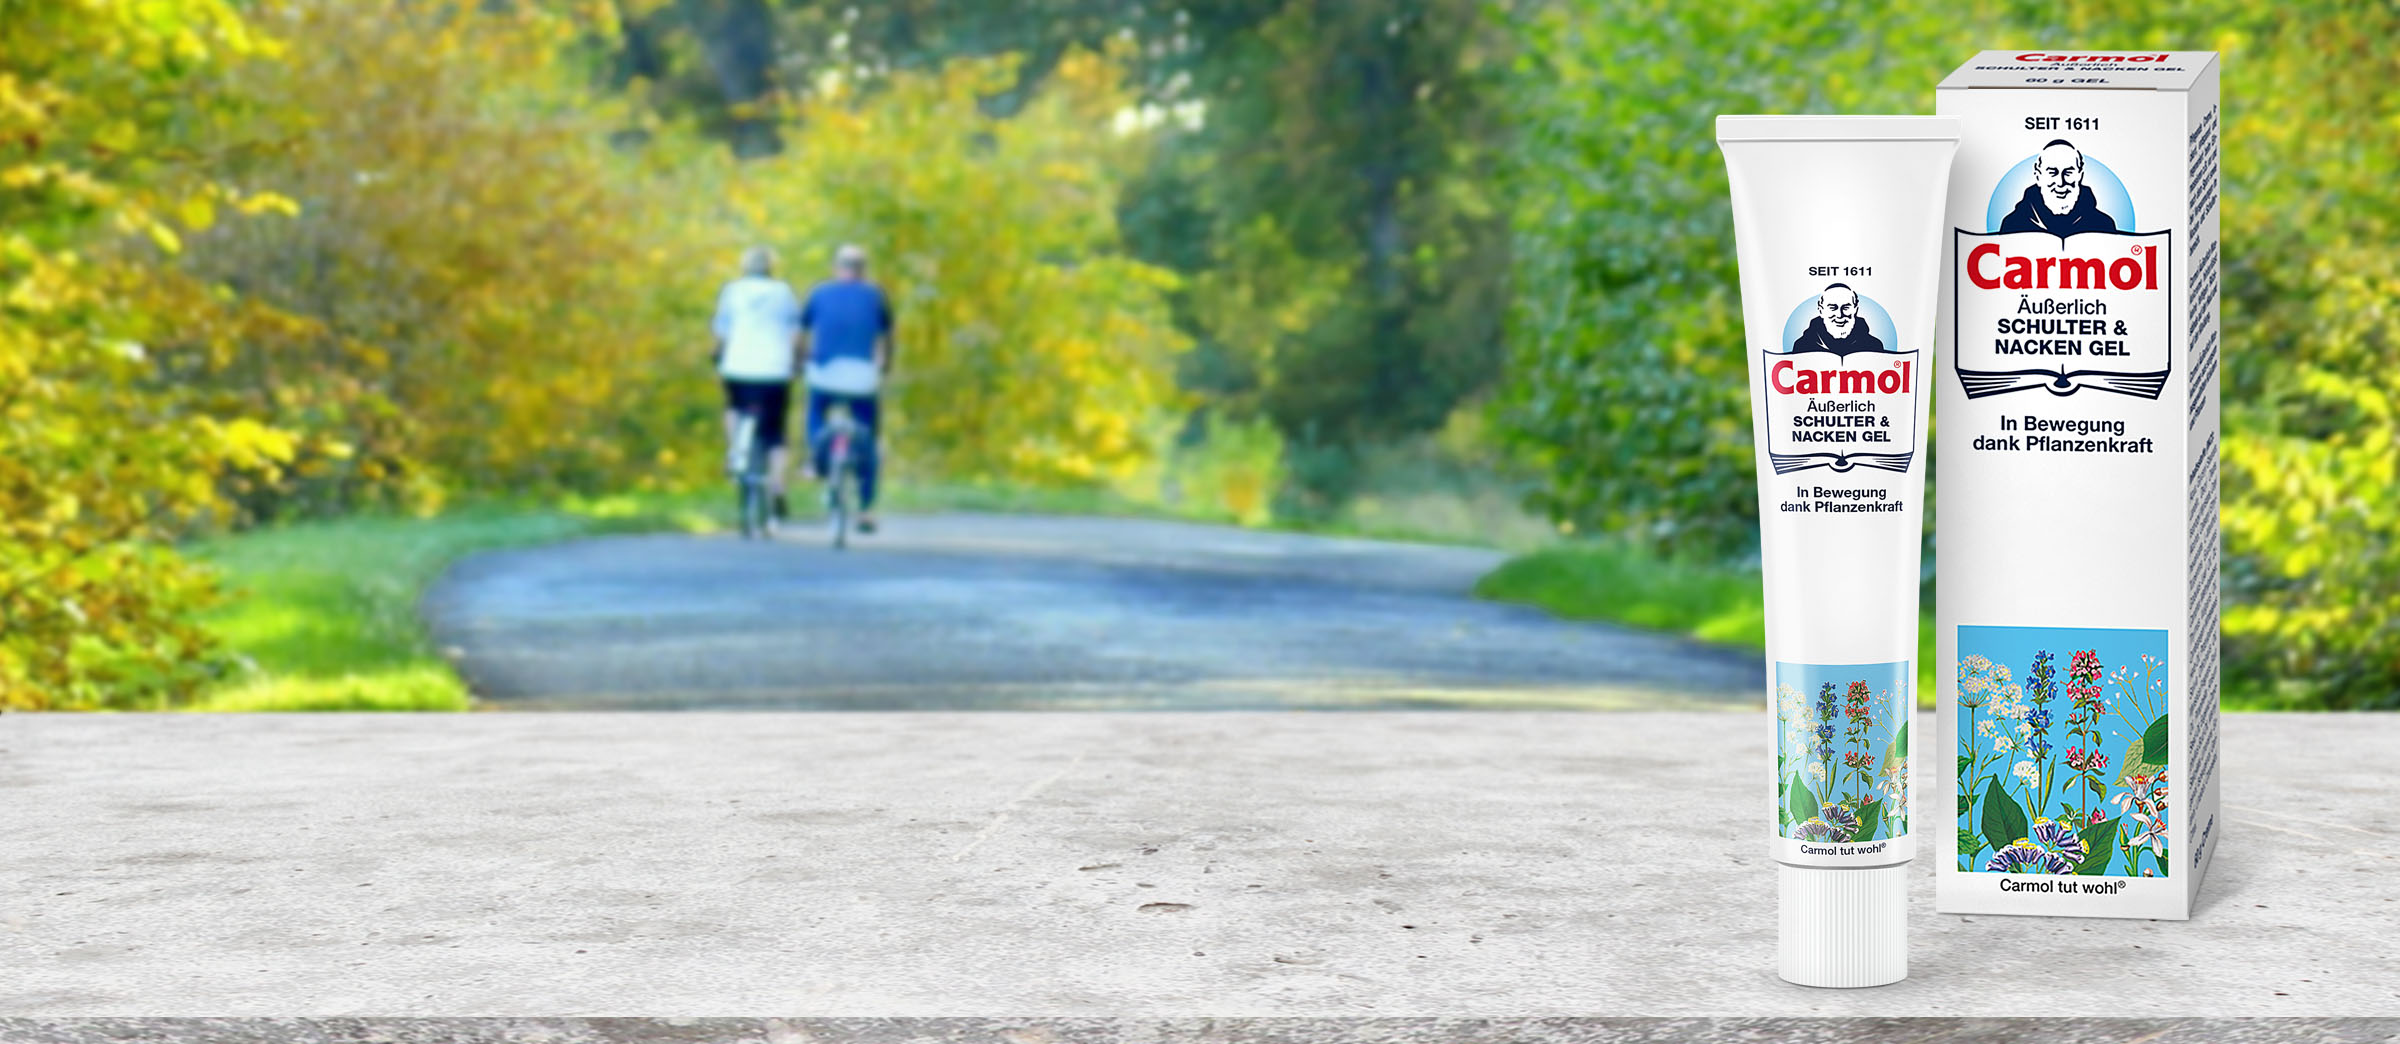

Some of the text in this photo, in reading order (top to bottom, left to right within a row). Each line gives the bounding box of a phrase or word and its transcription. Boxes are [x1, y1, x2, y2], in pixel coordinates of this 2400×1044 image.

[2015, 53, 2170, 62] Carmol
[2024, 117, 2099, 130] SEIT 1611
[1808, 266, 1872, 276] SEIT 1611
[1967, 243, 2158, 290] Carmol
[2017, 294, 2107, 315] Äußerlich
[1997, 318, 2128, 336] SCHULTER &
[1995, 339, 2130, 356] NACKEN GEL
[1771, 360, 1911, 395] Carmol
[1807, 397, 1876, 413] Äußerlich
[1793, 415, 1890, 428] SCHULTER &
[2000, 415, 2125, 436] In Bewegung
[1792, 431, 1891, 443] NACKEN GEL
[1973, 435, 2153, 453] dank Pflanzenkraft
[1797, 486, 1887, 500] In Bewegung
[1780, 501, 1903, 513] dank Pflanzenkraft
[1800, 844, 1837, 856] Carmol
[1840, 846, 1855, 856] tut
[2000, 878, 2054, 893] Carmol
[2058, 881, 2078, 894] tut
